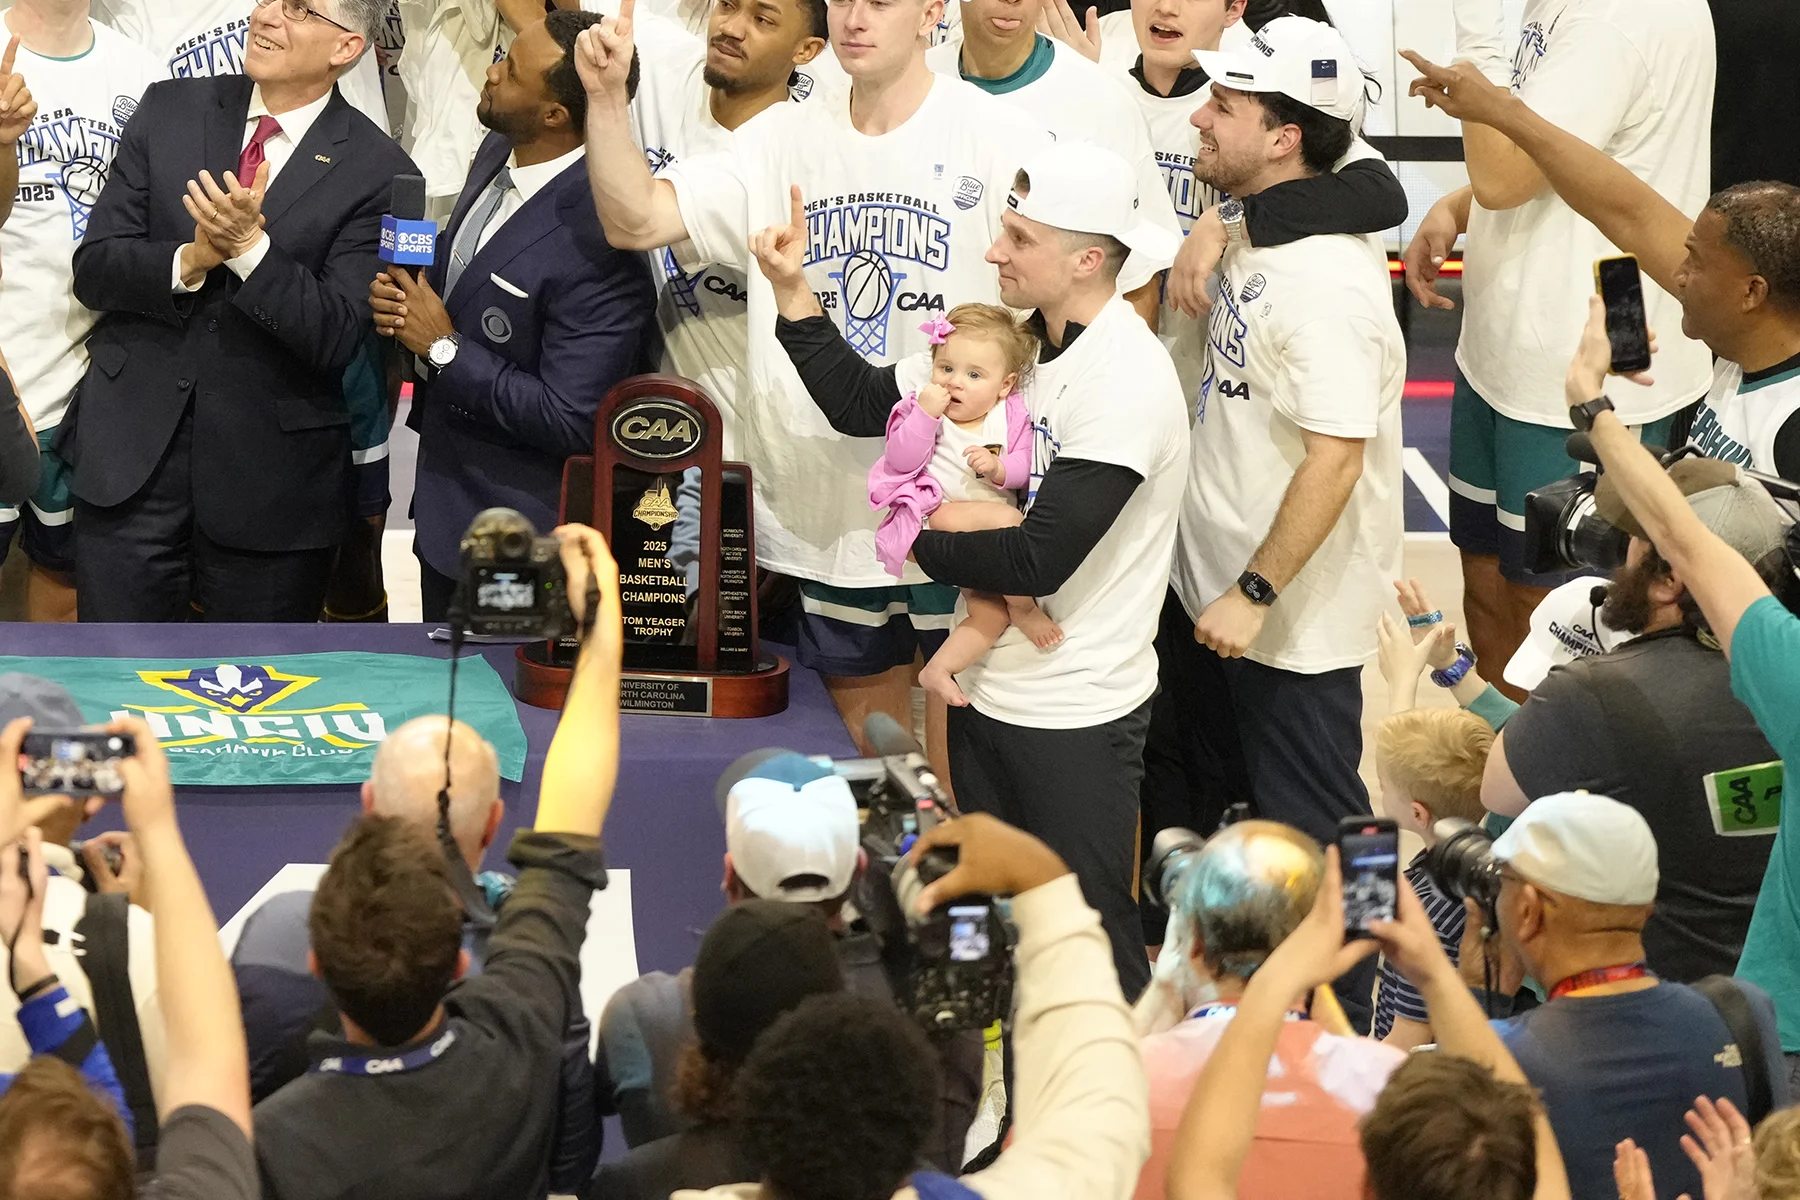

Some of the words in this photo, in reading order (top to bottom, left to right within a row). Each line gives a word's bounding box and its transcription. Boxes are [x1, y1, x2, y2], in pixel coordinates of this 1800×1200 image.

[176, 27, 223, 55] MEN'S
[960, 179, 982, 194] Blue
[803, 194, 844, 212] MEN'S
[848, 193, 940, 215] BASKETBALL
[387, 229, 395, 240] CBS
[408, 232, 433, 245] CBS
[380, 239, 395, 251] SPORTS
[397, 243, 433, 254] SPORTS
[896, 291, 946, 312] CAA
[1218, 380, 1251, 401] AA
[620, 417, 693, 442] CAA
[640, 496, 672, 508] CAA
[633, 509, 680, 519] CHAMPIONSHIP
[643, 541, 668, 552] 2025
[638, 557, 672, 569] MEN'S
[619, 574, 690, 587] BASKETBALL
[622, 592, 687, 604] CHAMPIONS
[622, 617, 642, 627] TOM
[645, 617, 686, 628] YEAGER
[634, 626, 674, 637] TROPHY
[1572, 624, 1595, 641] CAA
[620, 681, 667, 691] NIVERSITY
[669, 682, 680, 690] OF
[640, 691, 686, 701] CAROLINA
[619, 700, 675, 710] WILMINGTON
[291, 742, 354, 757] CLUB
[1729, 776, 1756, 825] CAA
